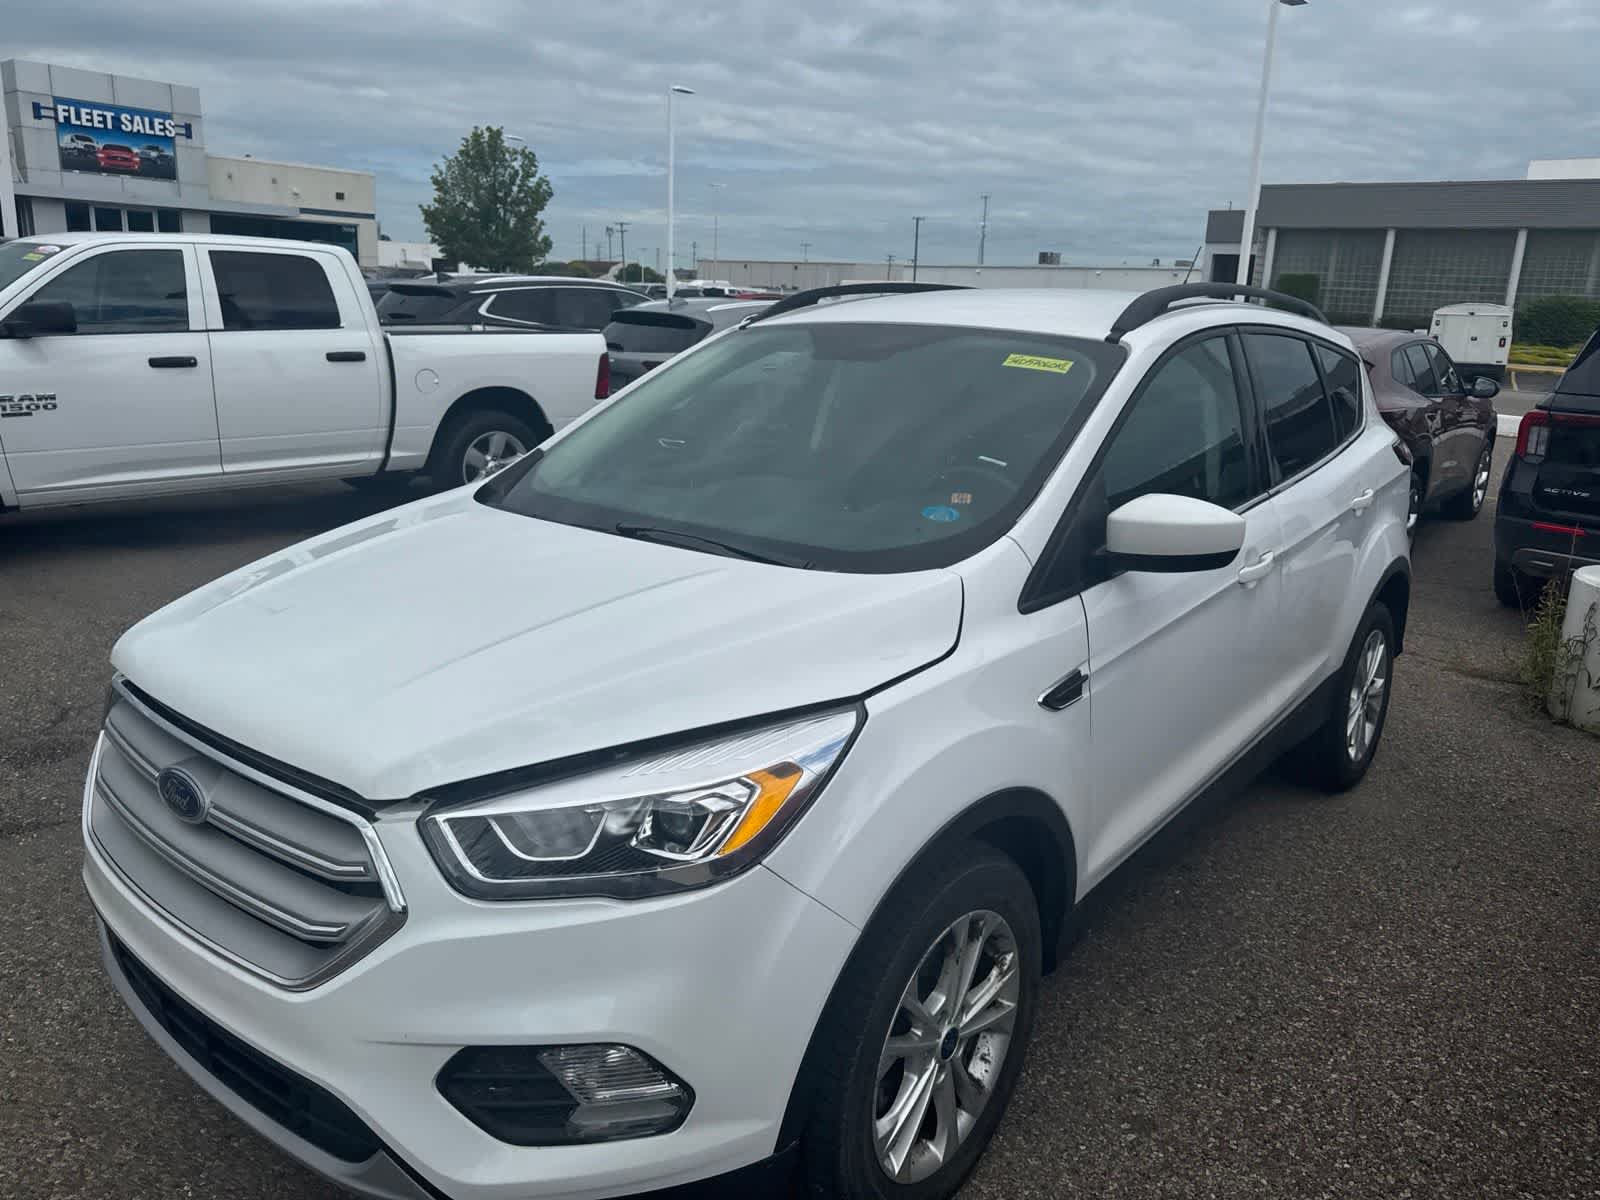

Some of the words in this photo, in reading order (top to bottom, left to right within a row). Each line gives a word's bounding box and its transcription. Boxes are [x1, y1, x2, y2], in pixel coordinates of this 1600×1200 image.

[57, 104, 115, 130] FLEET
[120, 113, 177, 138] SALES
[0, 394, 57, 402] RAM
[0, 402, 58, 411] 1500
[1543, 487, 1591, 497] ACTIVE
